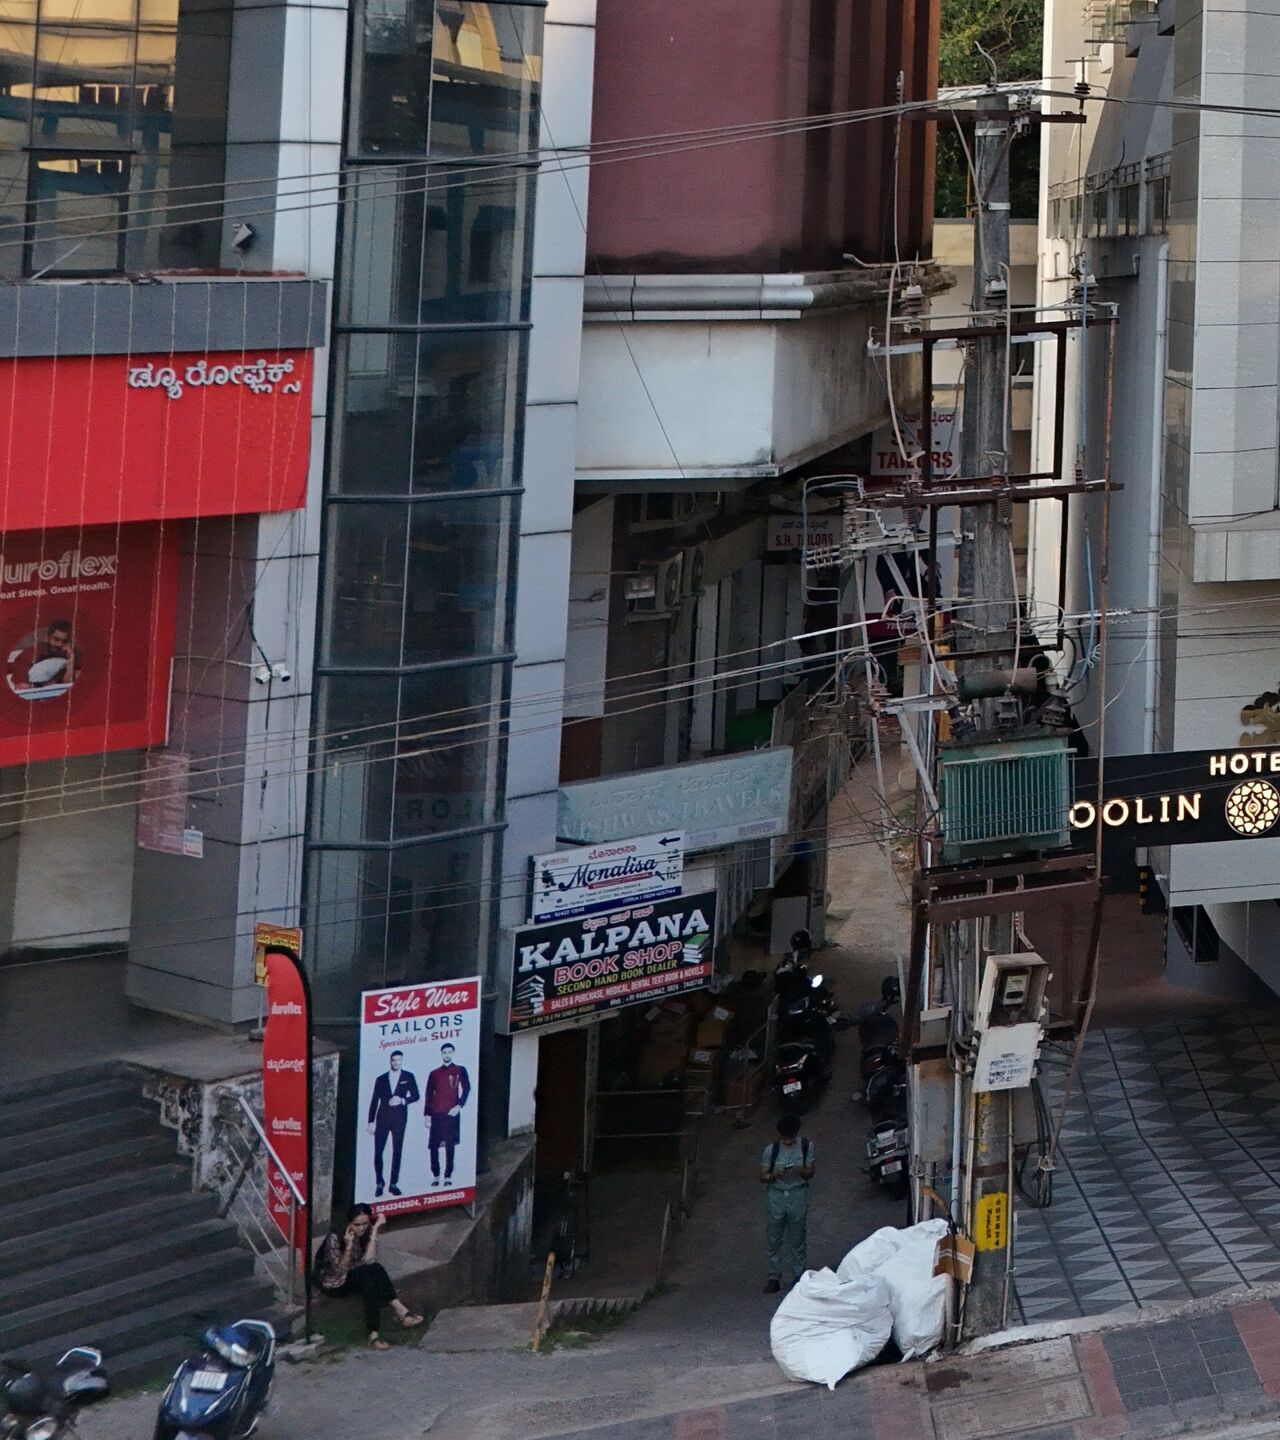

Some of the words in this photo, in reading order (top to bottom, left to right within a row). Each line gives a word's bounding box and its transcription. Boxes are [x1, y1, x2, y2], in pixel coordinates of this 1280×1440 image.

[796, 533, 834, 547] TILORS
[1069, 793, 1202, 829] OOLIN
[558, 856, 657, 891] Monalisa
[518, 909, 710, 973] KALPANA
[554, 954, 620, 986] BOOK
[623, 941, 683, 968] SHOP
[557, 980, 591, 996] SECOND
[594, 974, 618, 987] HAND
[621, 969, 644, 981] BOOK
[647, 960, 677, 976] DEALER
[374, 991, 420, 1018] Style
[425, 987, 469, 1008] Wear
[551, 997, 568, 1010] SALES
[631, 981, 650, 993] DENTAL
[651, 977, 664, 988] TEXT
[664, 972, 678, 983] BOOK
[684, 966, 704, 977] NOVELS
[378, 1035, 416, 1050] Specialist
[431, 1029, 462, 1041] SUIT
[379, 1014, 463, 1036] TAILORS
